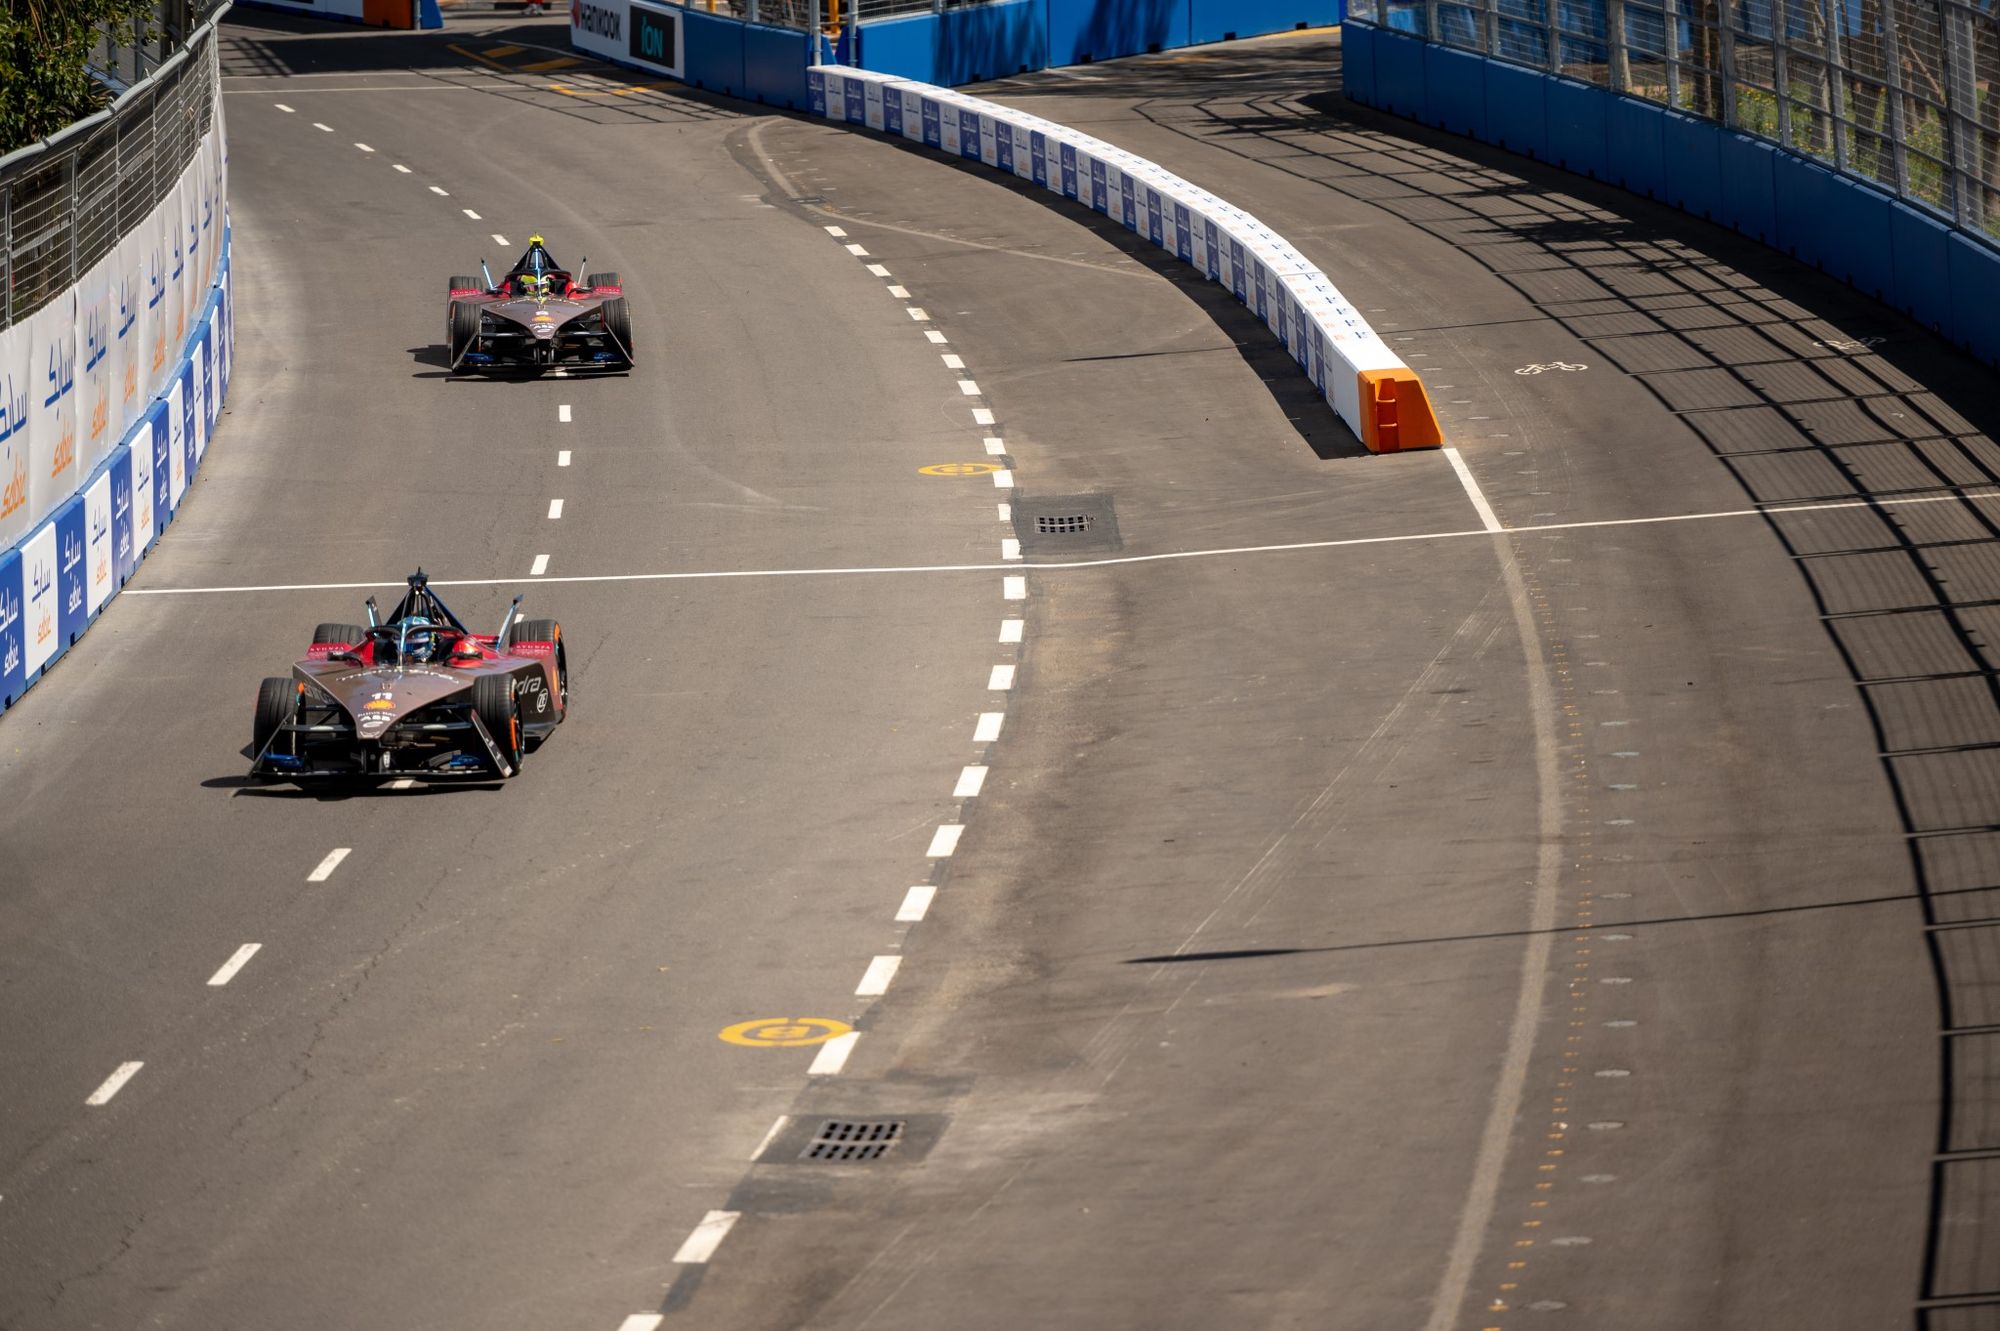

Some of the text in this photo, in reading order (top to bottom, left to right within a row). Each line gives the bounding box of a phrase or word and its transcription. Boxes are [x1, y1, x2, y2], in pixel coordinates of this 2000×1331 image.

[44, 338, 73, 421] سابك
[0, 452, 26, 520] sabic
[63, 529, 81, 581] سابك
